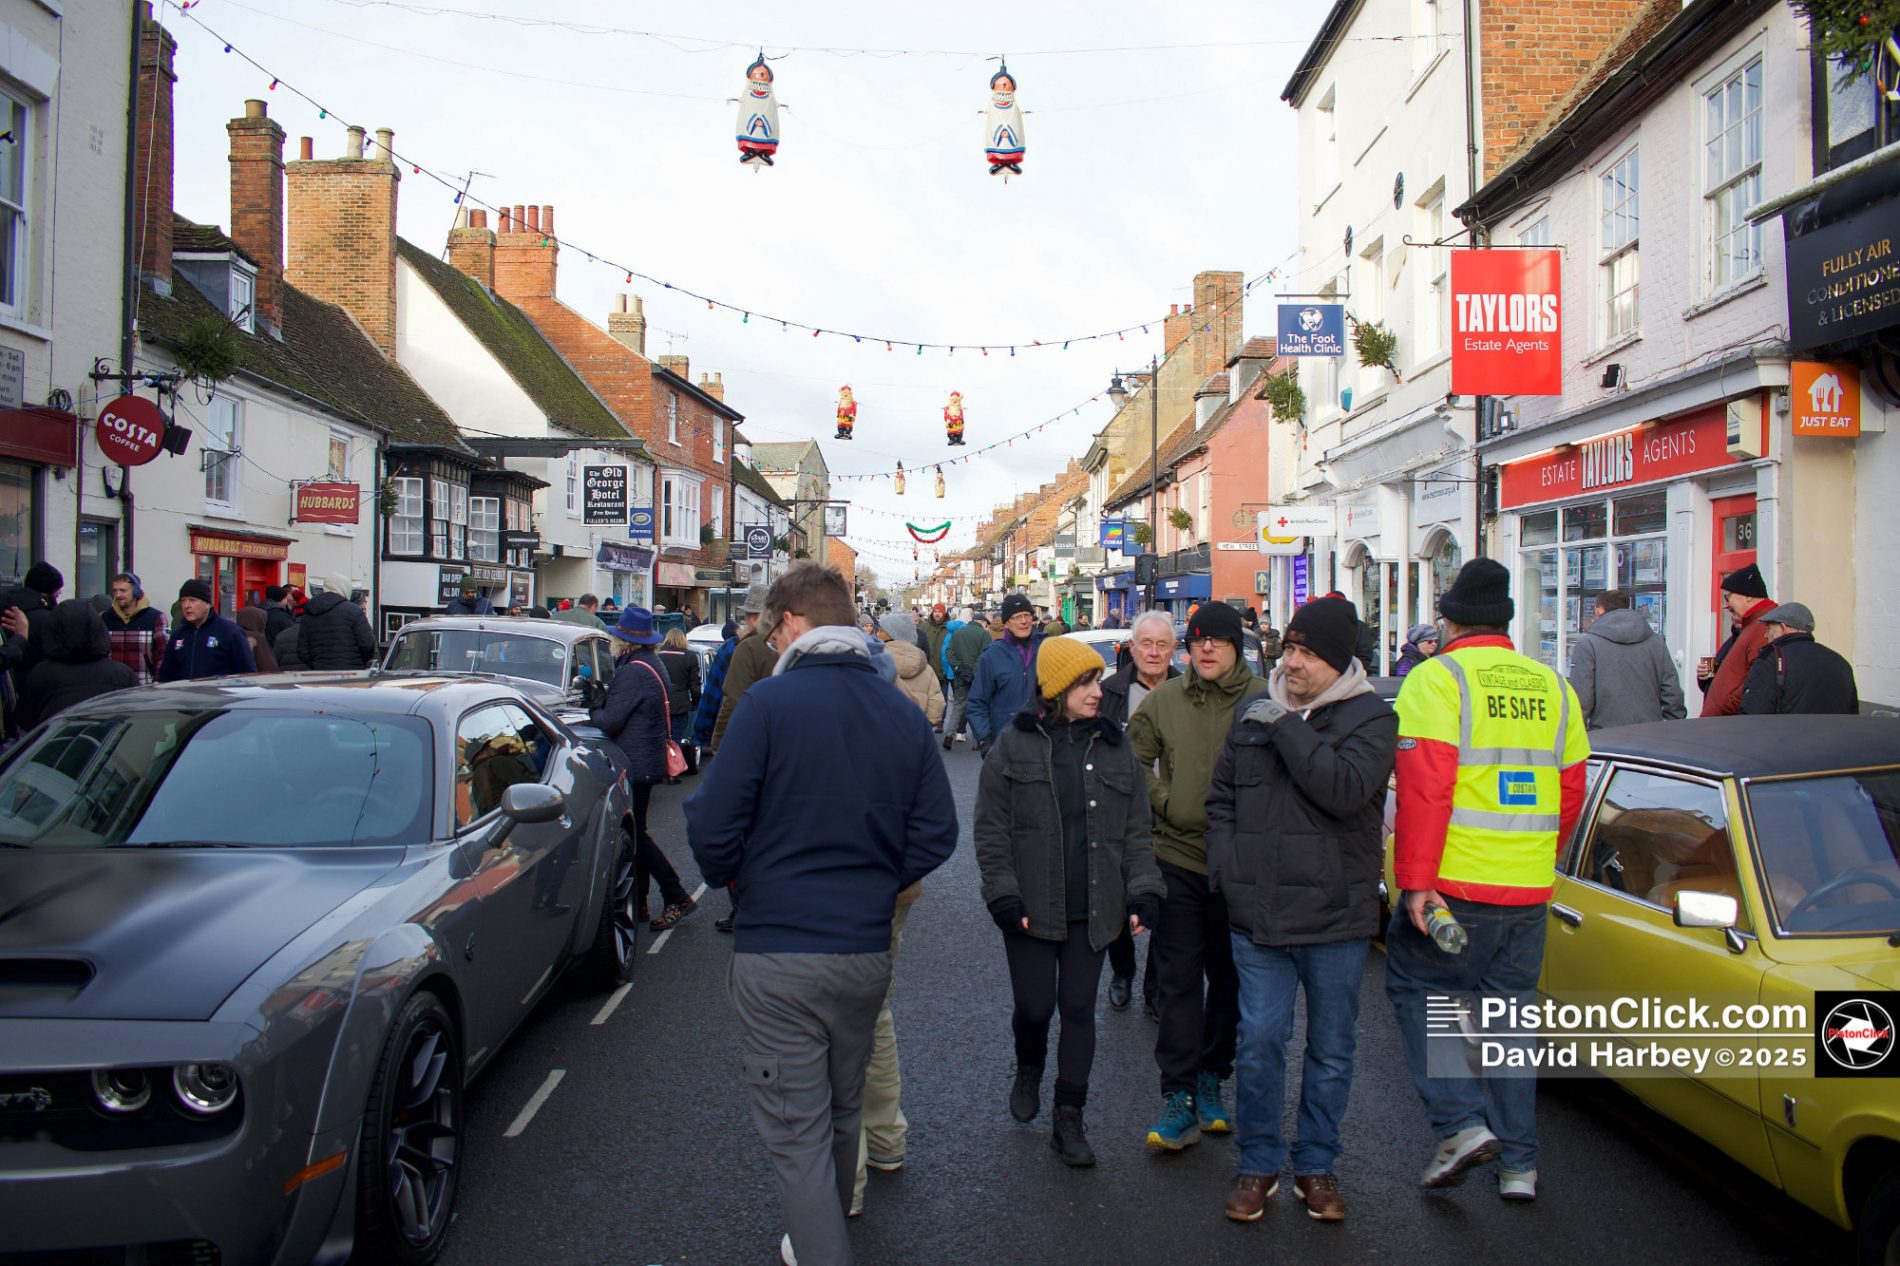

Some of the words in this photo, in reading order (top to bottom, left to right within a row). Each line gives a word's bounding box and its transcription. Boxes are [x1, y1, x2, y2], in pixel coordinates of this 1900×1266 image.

[1823, 248, 1864, 277] FULLY
[1866, 238, 1892, 262] AIR
[1455, 293, 1558, 333] TAYLORS
[1818, 310, 1829, 326] &
[1831, 287, 1900, 322] LICENSED
[1287, 334, 1308, 344] The
[1311, 334, 1335, 344] Foot
[1464, 338, 1502, 351] Estate
[1505, 338, 1550, 354] Agents
[1280, 344, 1311, 353] Health
[1314, 344, 1342, 353] Clinic
[103, 412, 157, 448] COSTA
[1800, 416, 1827, 428] JUST
[1830, 417, 1851, 427] EAT
[110, 433, 141, 452] COFFEE
[1542, 460, 1576, 487] ESTATE
[1581, 432, 1633, 490] TAYLORS
[1643, 429, 1696, 464] AGENTS
[602, 467, 622, 478] Old
[587, 477, 624, 489] George
[300, 495, 356, 510] HUBBARDS
[591, 489, 620, 501] Hotel
[1738, 523, 1752, 540] 36
[197, 536, 241, 553] HUBBARDS
[442, 573, 451, 583] BAR
[1487, 695, 1507, 718] BE
[1510, 696, 1547, 721] SAFE
